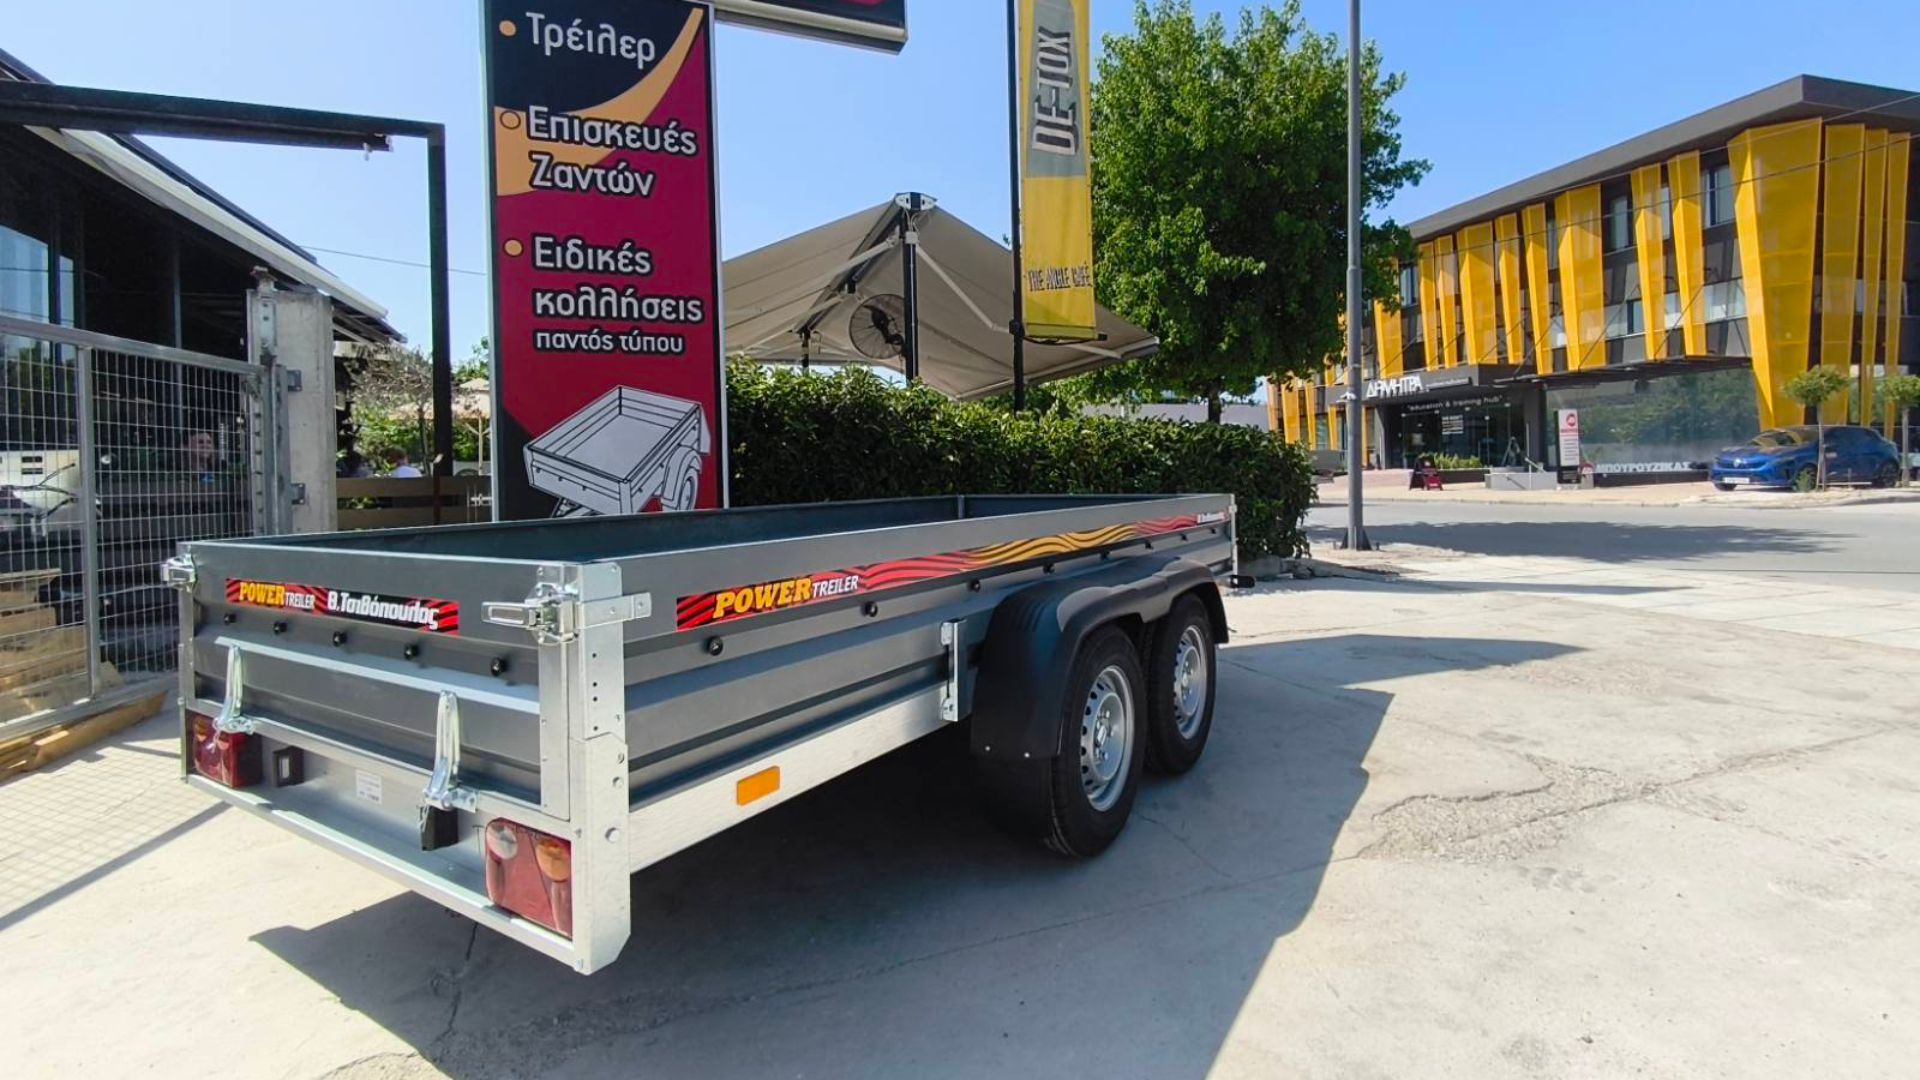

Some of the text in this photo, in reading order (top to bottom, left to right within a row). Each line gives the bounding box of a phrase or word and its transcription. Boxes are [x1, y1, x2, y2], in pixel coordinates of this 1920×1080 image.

[526, 11, 656, 69] Τρέιλερ
[1031, 26, 1078, 156] DE-TOX
[528, 105, 698, 155] Επισκευές
[530, 154, 655, 197] Ζαντών
[534, 237, 651, 274] Ειδικές
[1028, 269, 1045, 292] THE
[535, 287, 702, 323] κολλήσεις
[536, 329, 683, 353] παντός τύπου
[239, 581, 285, 606] POWER
[713, 575, 859, 619] POWER TREILER
